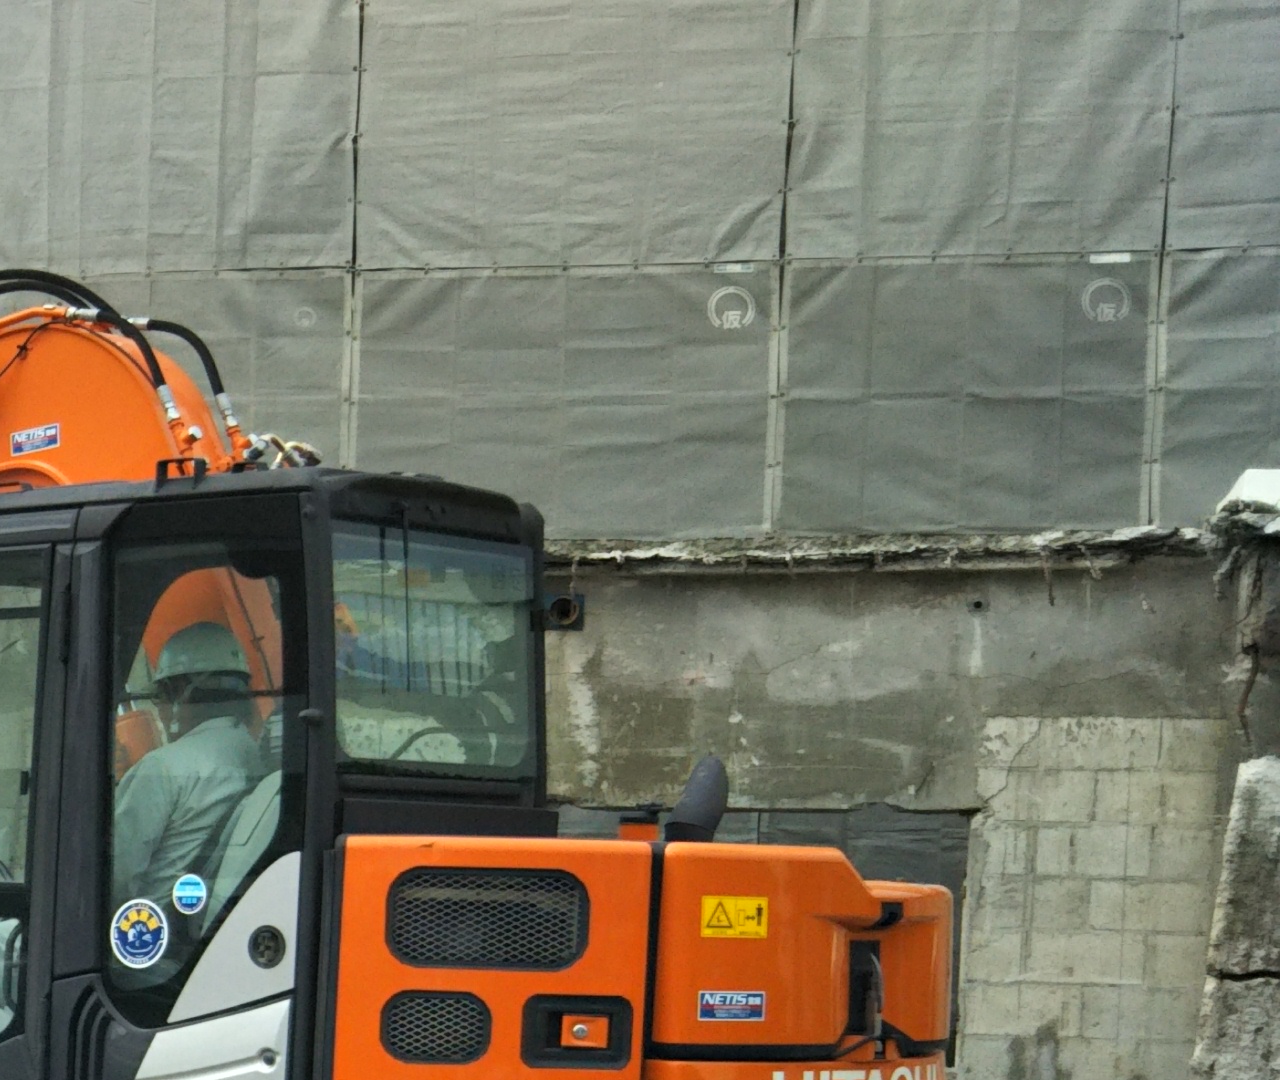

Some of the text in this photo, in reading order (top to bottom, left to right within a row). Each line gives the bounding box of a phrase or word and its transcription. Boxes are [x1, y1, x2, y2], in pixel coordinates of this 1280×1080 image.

[722, 310, 742, 330] 仮
[13, 428, 46, 443] NETIS
[702, 993, 747, 1005] NETIS
